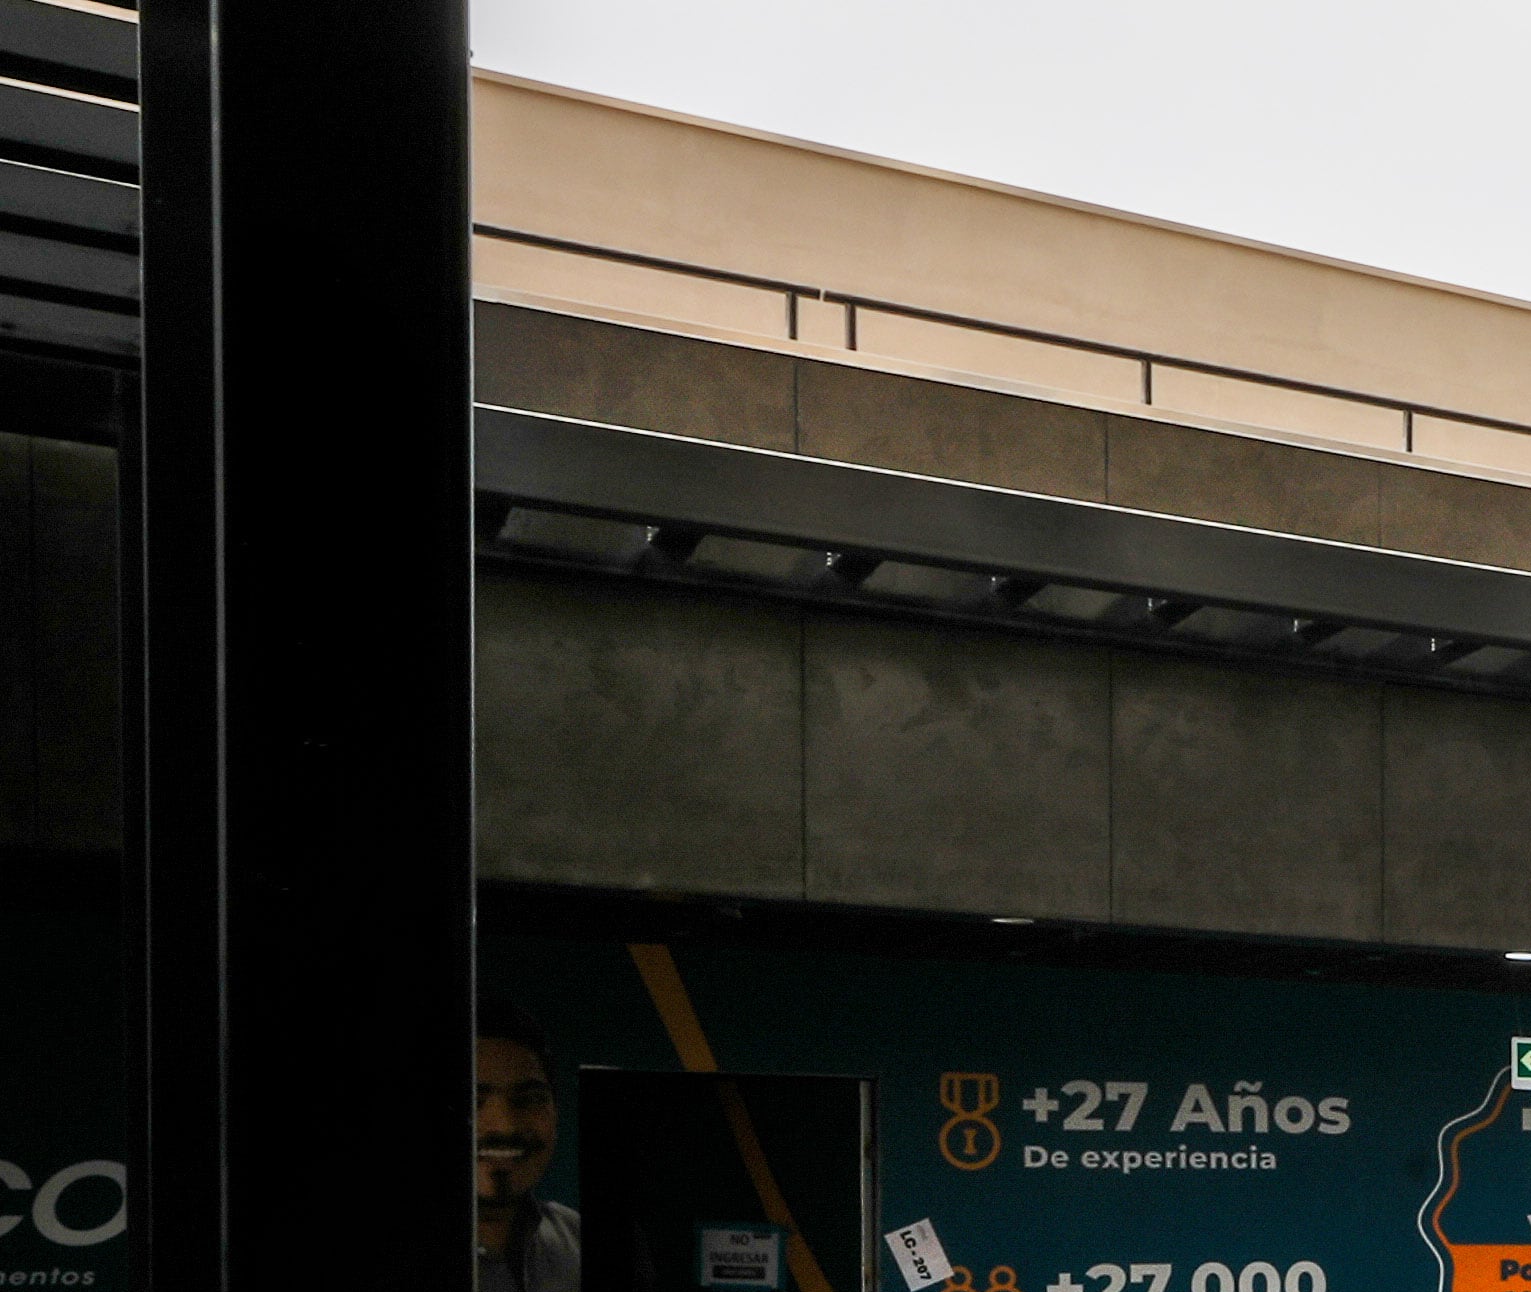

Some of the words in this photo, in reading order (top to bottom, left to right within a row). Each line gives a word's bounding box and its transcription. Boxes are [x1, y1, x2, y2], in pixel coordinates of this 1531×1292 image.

[1023, 1081, 1148, 1132] +27
[1170, 1081, 1351, 1134] Años
[1024, 1146, 1069, 1168] De
[1081, 1145, 1277, 1174] experiencia
[913, 1258, 932, 1280] 207
